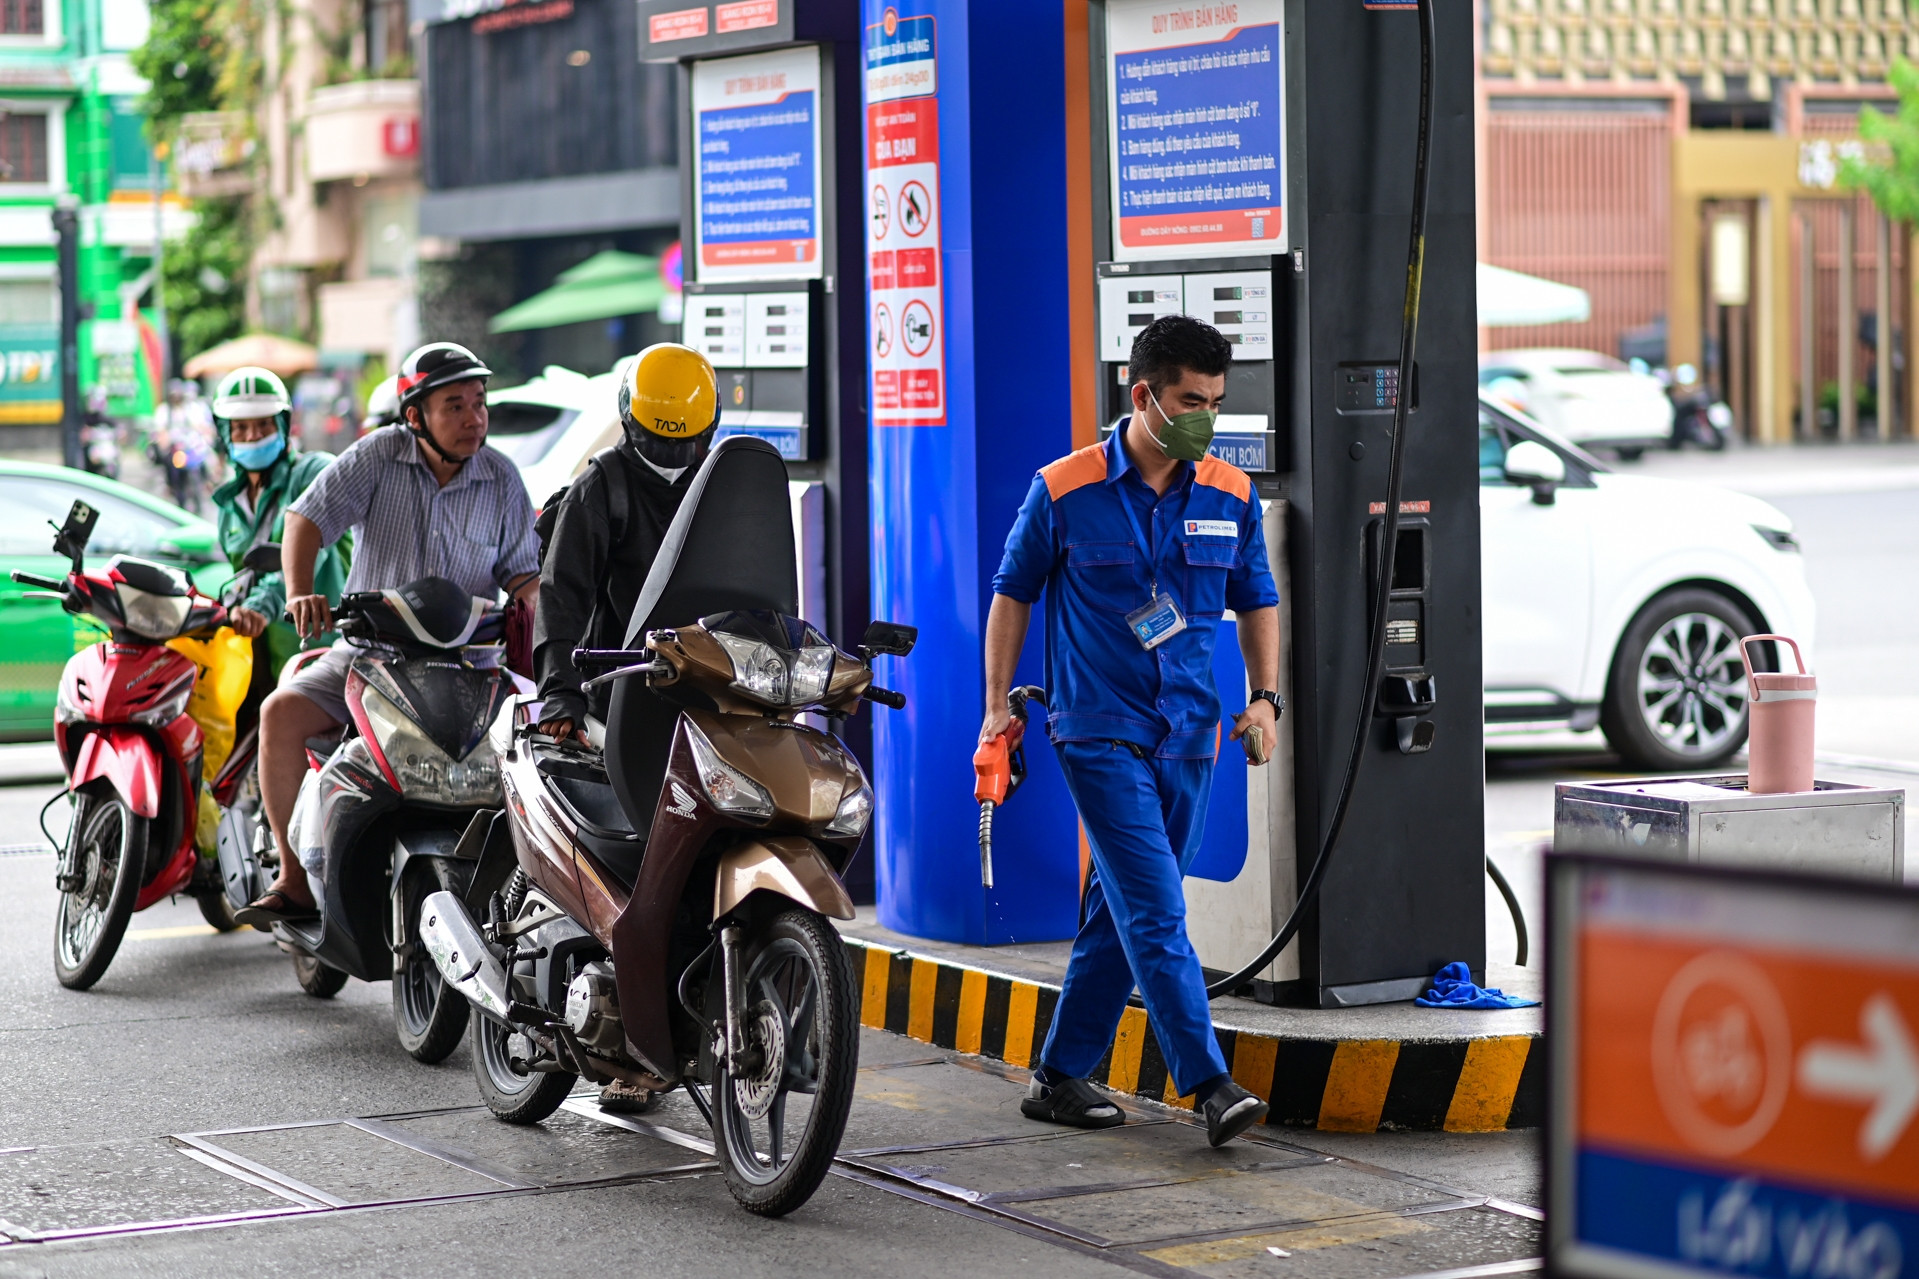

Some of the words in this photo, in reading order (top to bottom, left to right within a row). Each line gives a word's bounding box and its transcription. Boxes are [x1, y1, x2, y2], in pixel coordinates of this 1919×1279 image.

[1152, 14, 1168, 33] QUY
[1170, 8, 1194, 32] TRÌNH
[1196, 3, 1212, 28] BÁN
[1215, 1, 1238, 25] HÀNG
[907, 37, 930, 54] HÀNG
[1166, 58, 1178, 77] hàng
[1129, 88, 1144, 104] khách
[1151, 112, 1163, 130] hàng
[893, 138, 916, 162] BẠN
[1139, 138, 1152, 157] hàng
[1211, 131, 1226, 147] khách
[1152, 162, 1164, 182] hàng
[654, 417, 687, 433] TADA
[1238, 444, 1262, 466] BƠM
[1198, 524, 1236, 532] PETROLIMEX
[427, 661, 462, 670] HONDA
[347, 770, 374, 790] HONDA
[665, 805, 697, 821] HONDA
